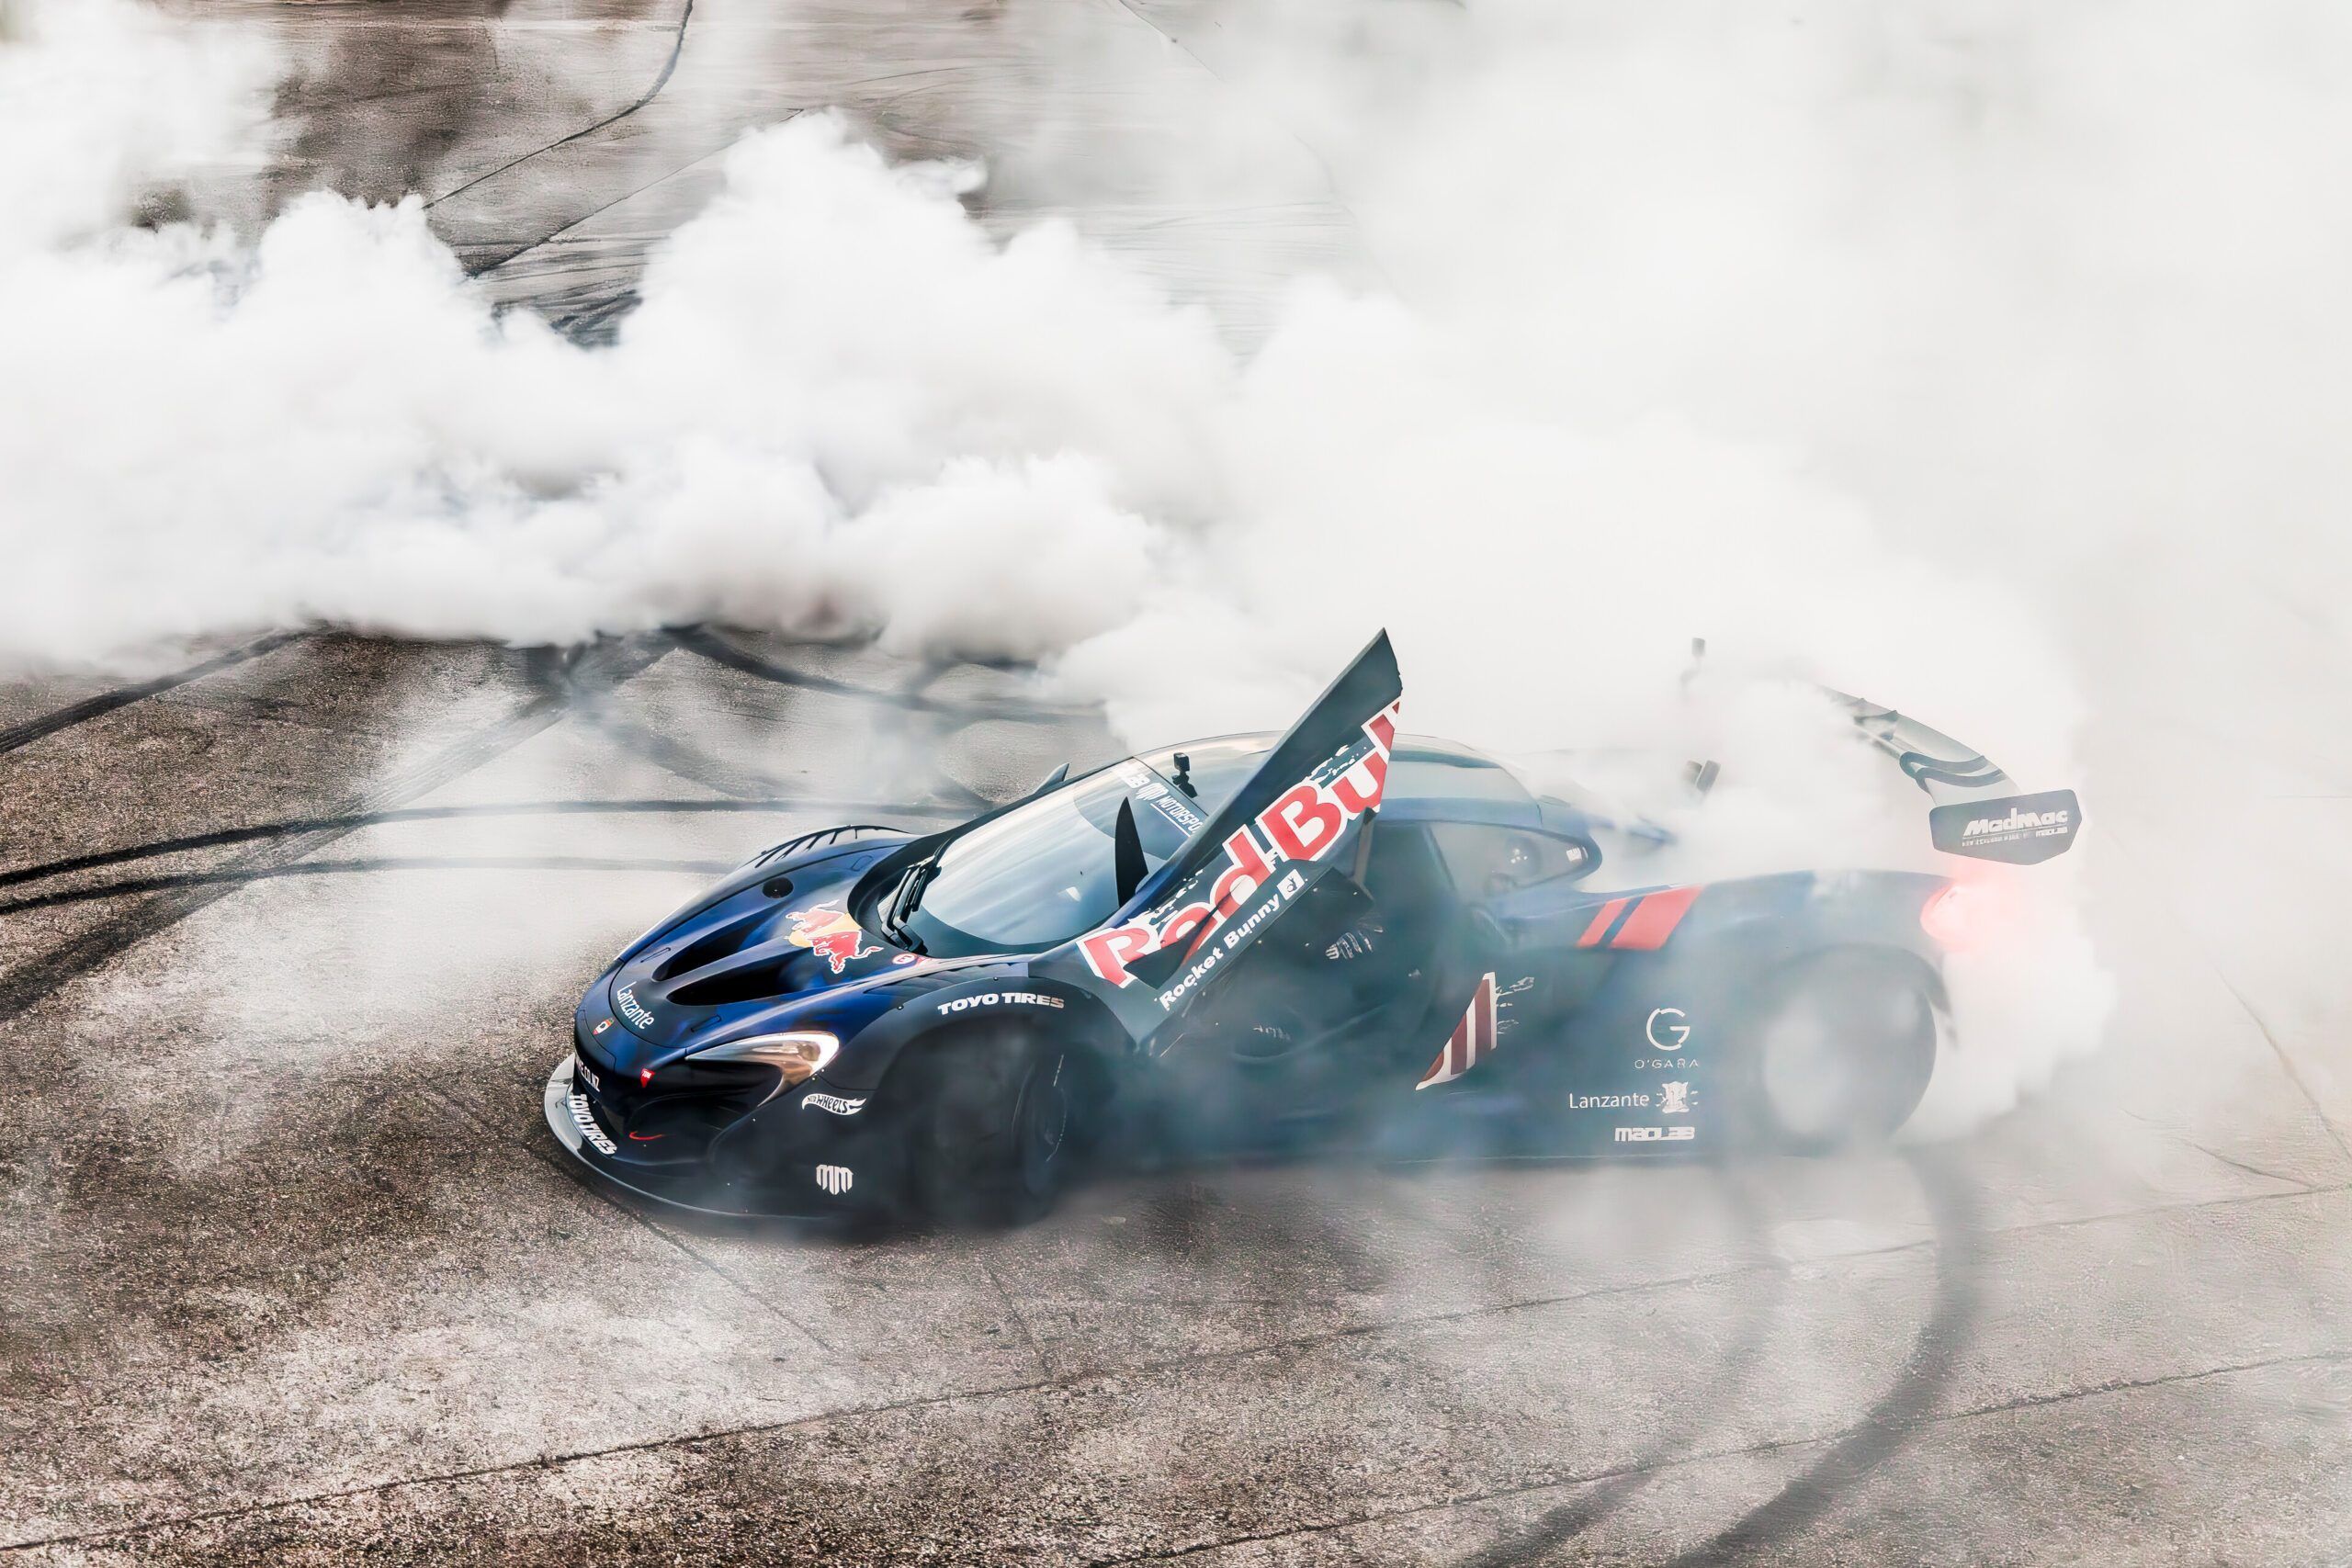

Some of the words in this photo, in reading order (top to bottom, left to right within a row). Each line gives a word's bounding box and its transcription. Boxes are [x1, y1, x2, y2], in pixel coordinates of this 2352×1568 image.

[1256, 696, 1400, 862] Bu
[1155, 795, 1204, 833] MOTORSPO
[1159, 946, 1224, 1011] Rocket
[1223, 893, 1281, 950] Bunny
[616, 981, 655, 1030] Lanzante
[938, 994, 1000, 1016] TOYO
[1001, 992, 1065, 1010] TIRES
[1645, 1008, 1690, 1051] G
[569, 1093, 594, 1123] TOYO
[1569, 1092, 1650, 1110] Lanzante
[579, 1122, 618, 1155] TIRES
